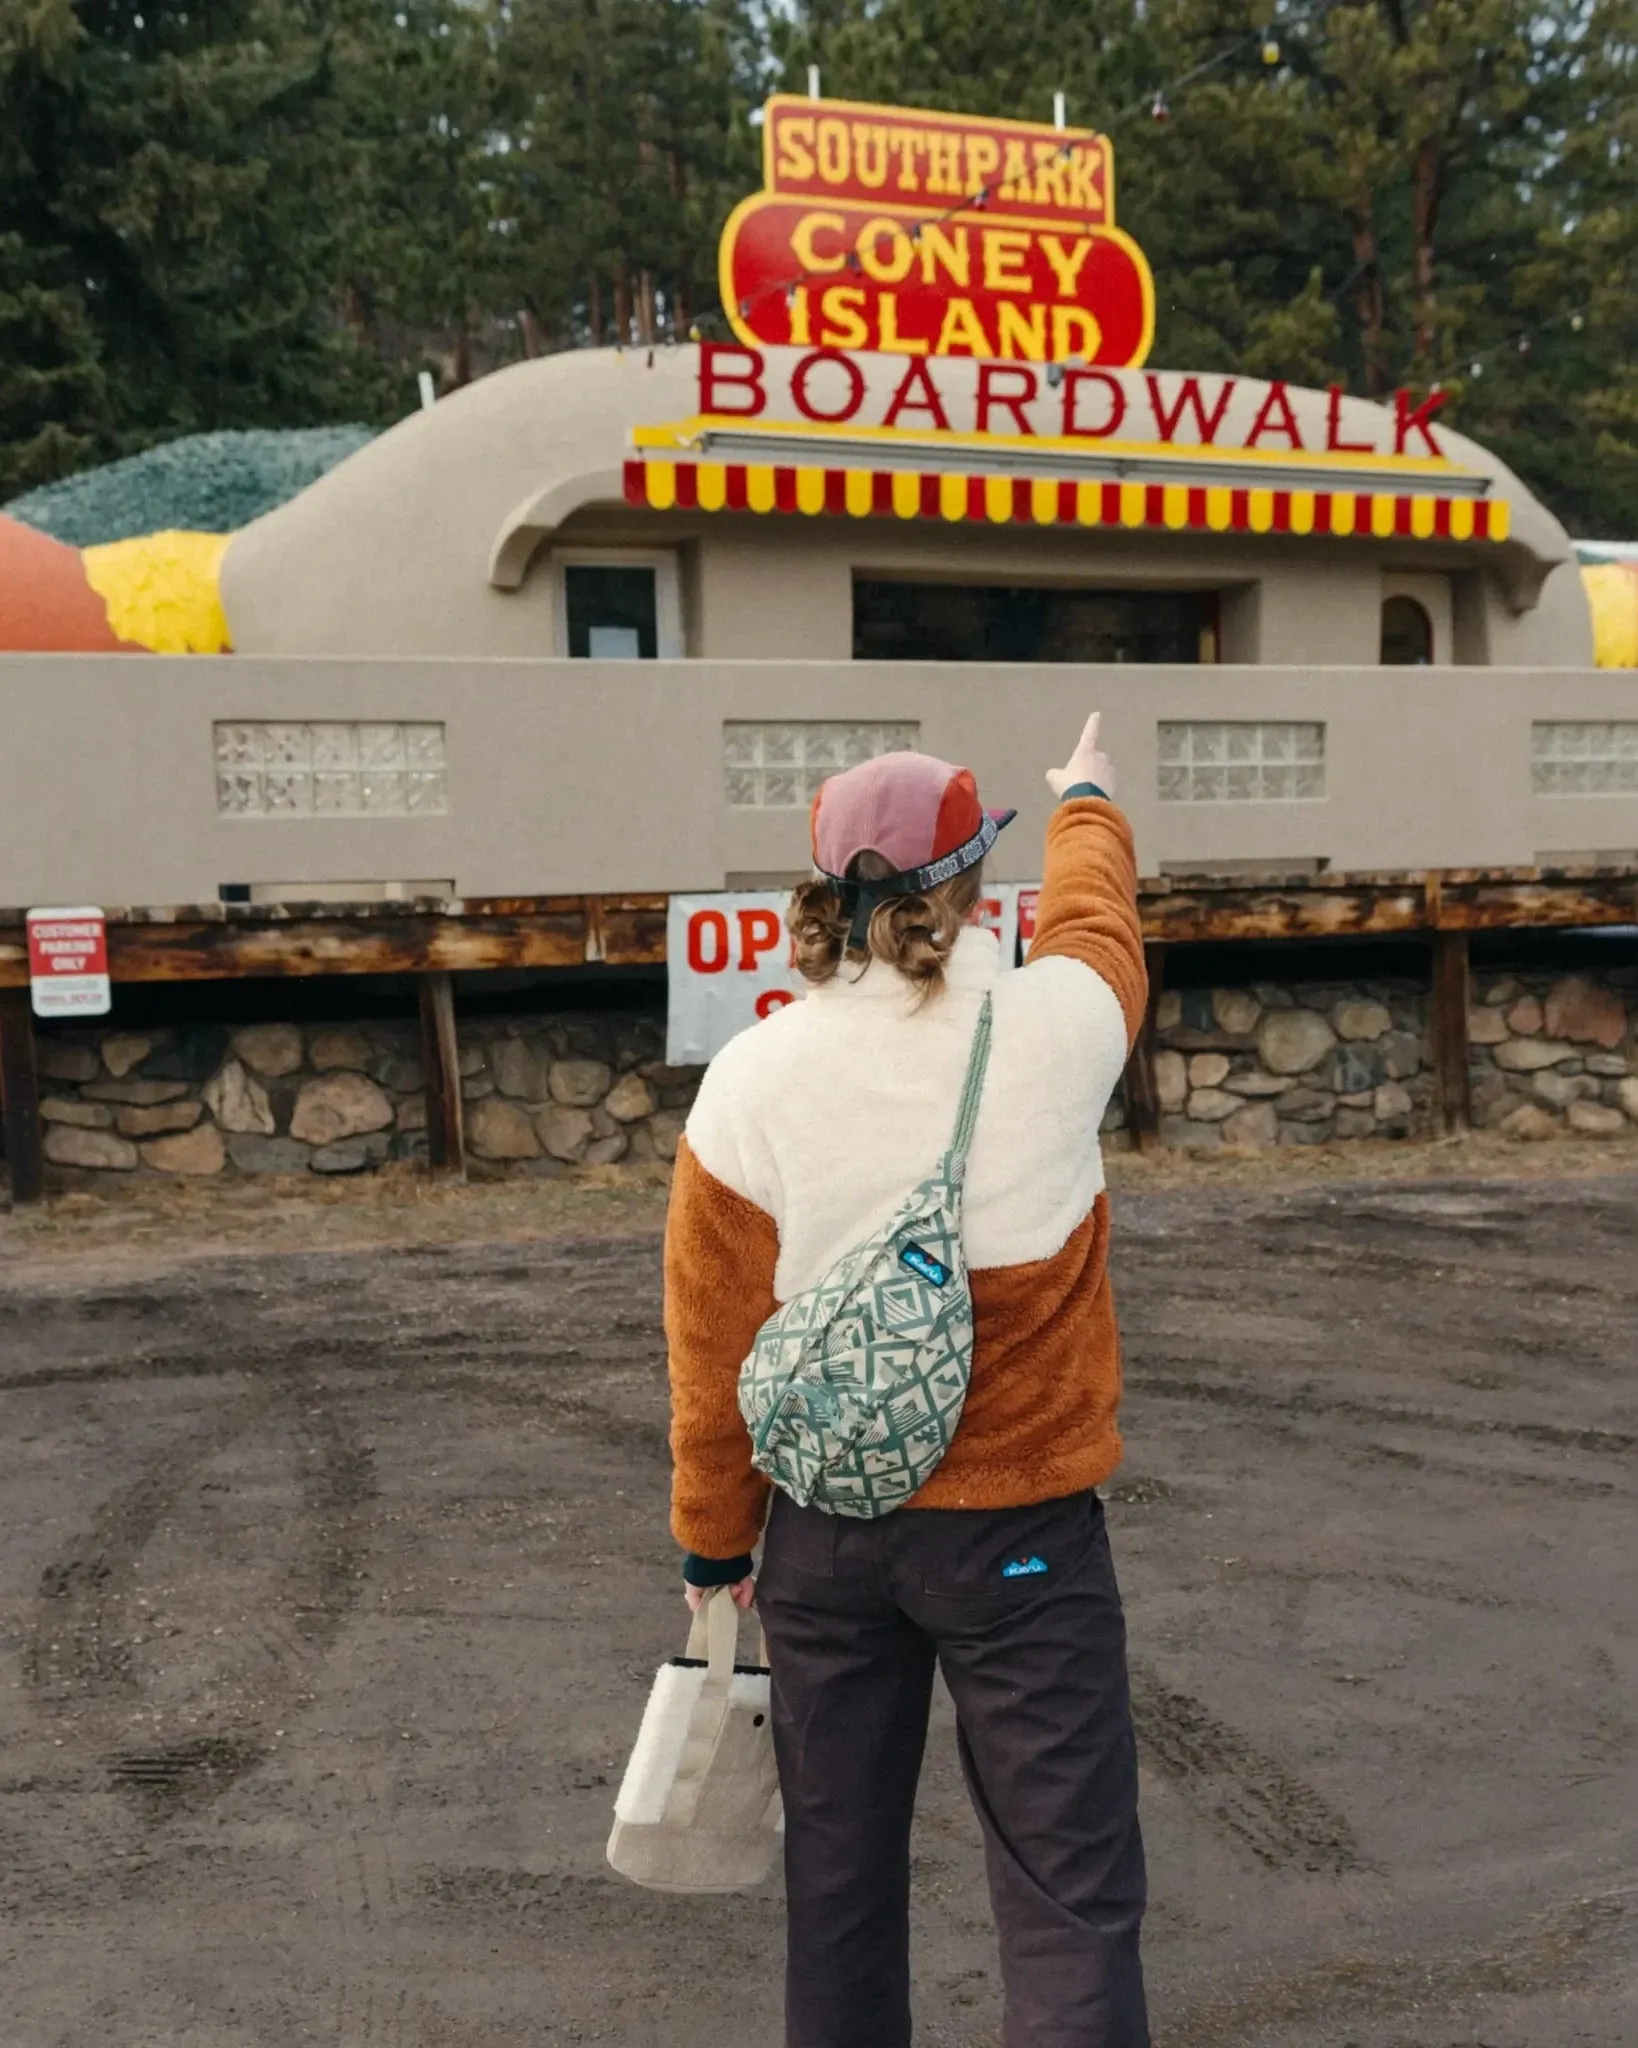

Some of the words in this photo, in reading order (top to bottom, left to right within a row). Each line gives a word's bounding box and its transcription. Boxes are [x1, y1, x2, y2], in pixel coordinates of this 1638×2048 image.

[777, 117, 1103, 208] SOUTHPARK
[791, 212, 1094, 297] CONEY
[789, 286, 1103, 366] ISLAND
[698, 343, 1449, 457] BOARDWALK
[51, 956, 86, 972] ONLY
